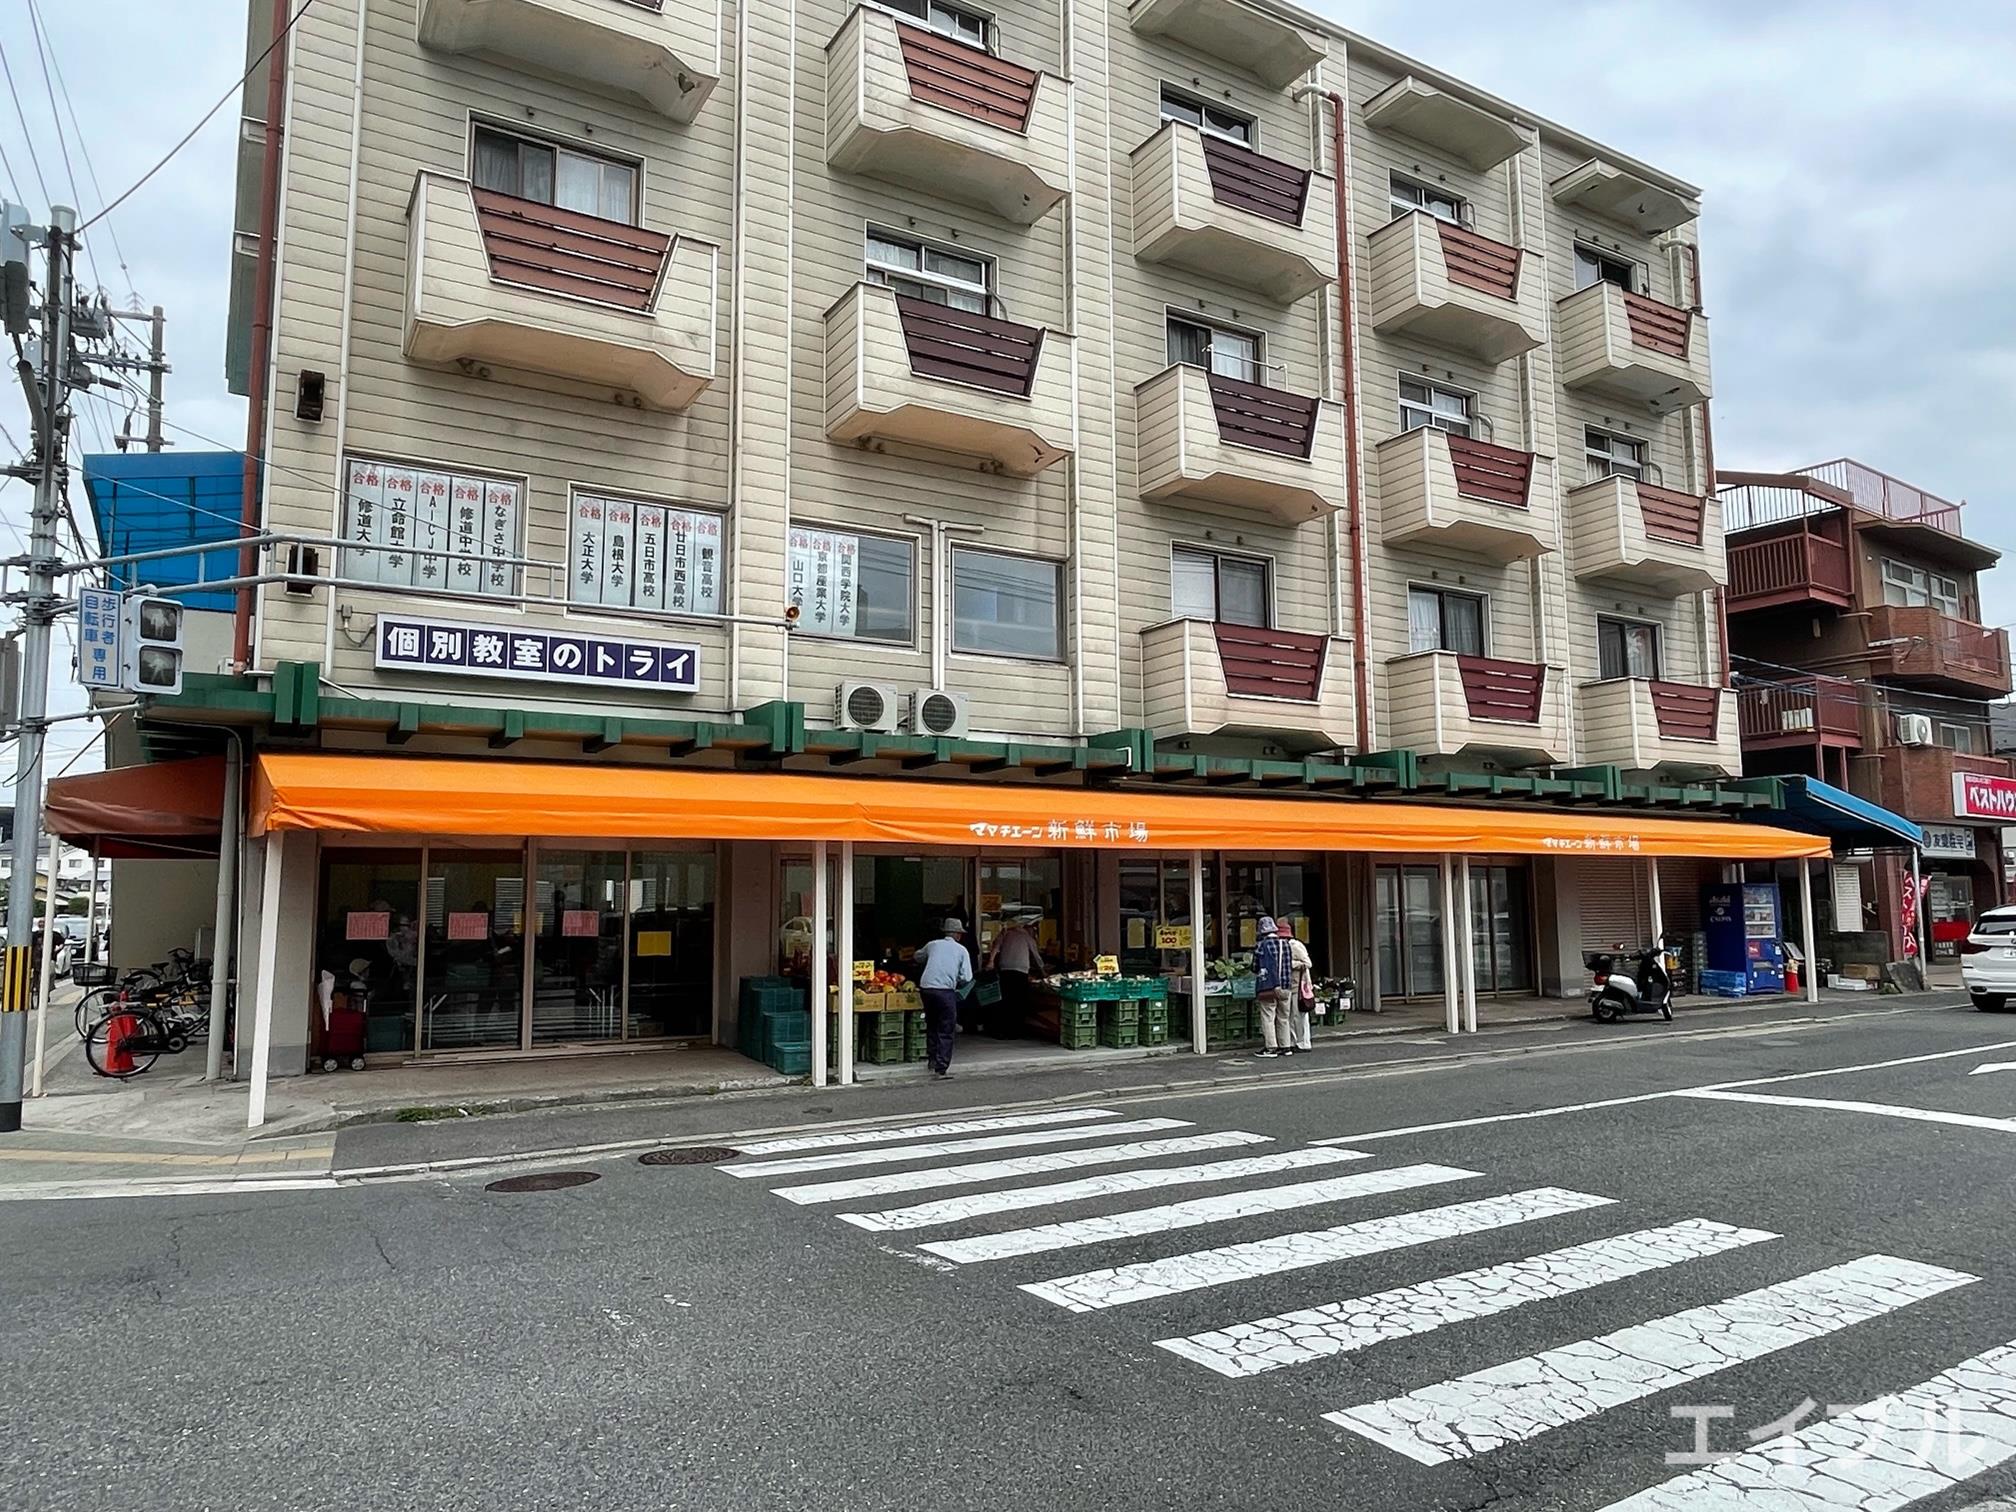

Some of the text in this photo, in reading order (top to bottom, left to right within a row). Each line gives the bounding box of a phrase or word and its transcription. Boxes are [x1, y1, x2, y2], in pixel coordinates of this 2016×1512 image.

[353, 472, 379, 486] 合格
[386, 477, 412, 491] 合格
[420, 481, 445, 496] 合格
[454, 485, 479, 501] 合格
[488, 490, 512, 505] 合格
[579, 504, 601, 520] 合格
[609, 510, 630, 524] 合格
[640, 514, 661, 528] 合格
[671, 518, 692, 532] 合格
[697, 522, 717, 536] 合格
[580, 531, 595, 584] 大正大学
[611, 535, 624, 587] 島根大学
[643, 533, 656, 597] 五日市高校
[673, 531, 686, 608] 廿日市西高校
[701, 548, 713, 598] 観音高校
[792, 560, 803, 607] 山口大学
[102, 598, 116, 645] 歩行者
[387, 626, 689, 679] 個別教室のトライ
[1970, 786, 2016, 812] ベストハウ
